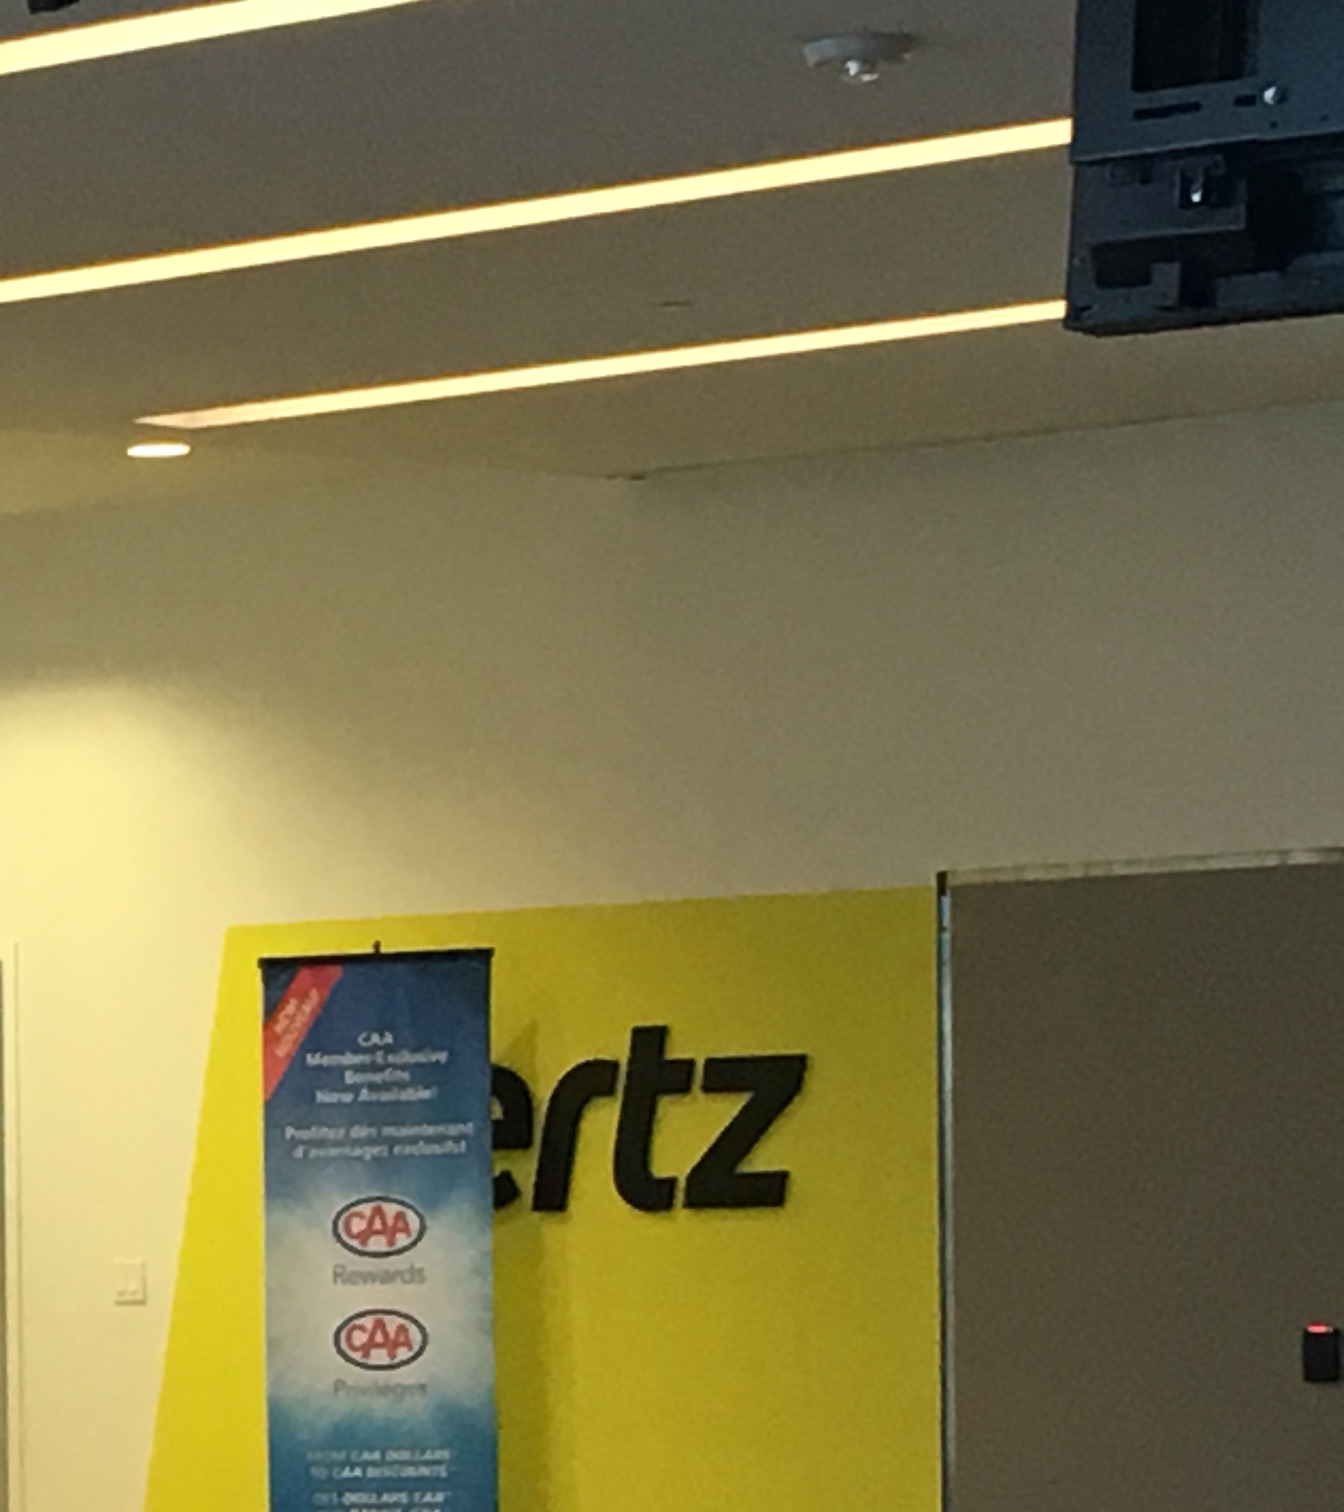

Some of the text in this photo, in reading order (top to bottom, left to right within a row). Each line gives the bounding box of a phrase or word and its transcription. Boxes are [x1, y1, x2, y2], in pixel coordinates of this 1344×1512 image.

[357, 1030, 394, 1047] CAA
[344, 1068, 410, 1084] Benefits
[491, 1025, 808, 1213] rtz
[343, 1205, 412, 1248] CAA
[332, 1263, 427, 1286] Rewards
[344, 1317, 414, 1361] CAA
[350, 1449, 381, 1462] CAA
[332, 1466, 363, 1479] CAA
